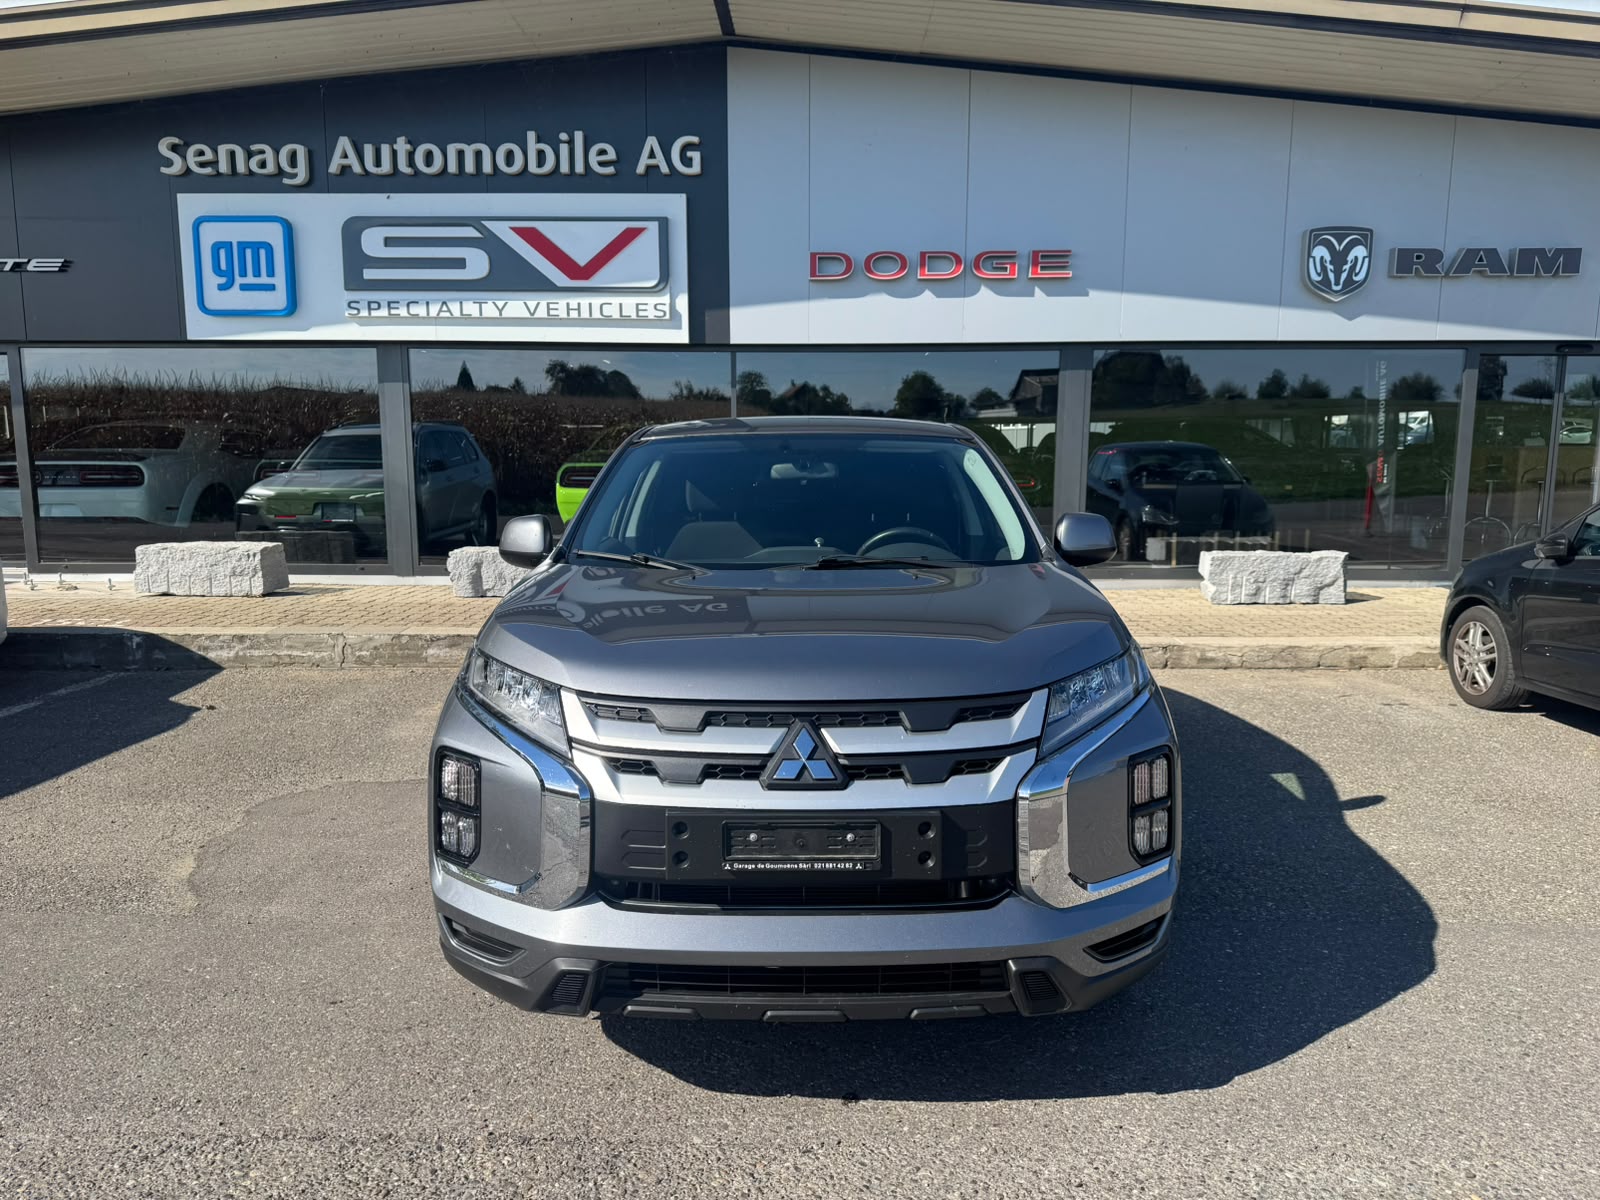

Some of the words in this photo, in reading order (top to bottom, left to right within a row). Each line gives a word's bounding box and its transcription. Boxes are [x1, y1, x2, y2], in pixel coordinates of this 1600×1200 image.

[157, 136, 310, 187] Senag
[328, 130, 619, 177] Automobile
[635, 135, 703, 176] AG
[210, 239, 276, 292] gm
[359, 223, 648, 282] SV
[809, 249, 1073, 281] DODGE
[1388, 246, 1582, 278] RAM
[347, 299, 509, 318] SPECIALTY
[523, 301, 670, 320] VEHICLES
[733, 862, 756, 870] Garage
